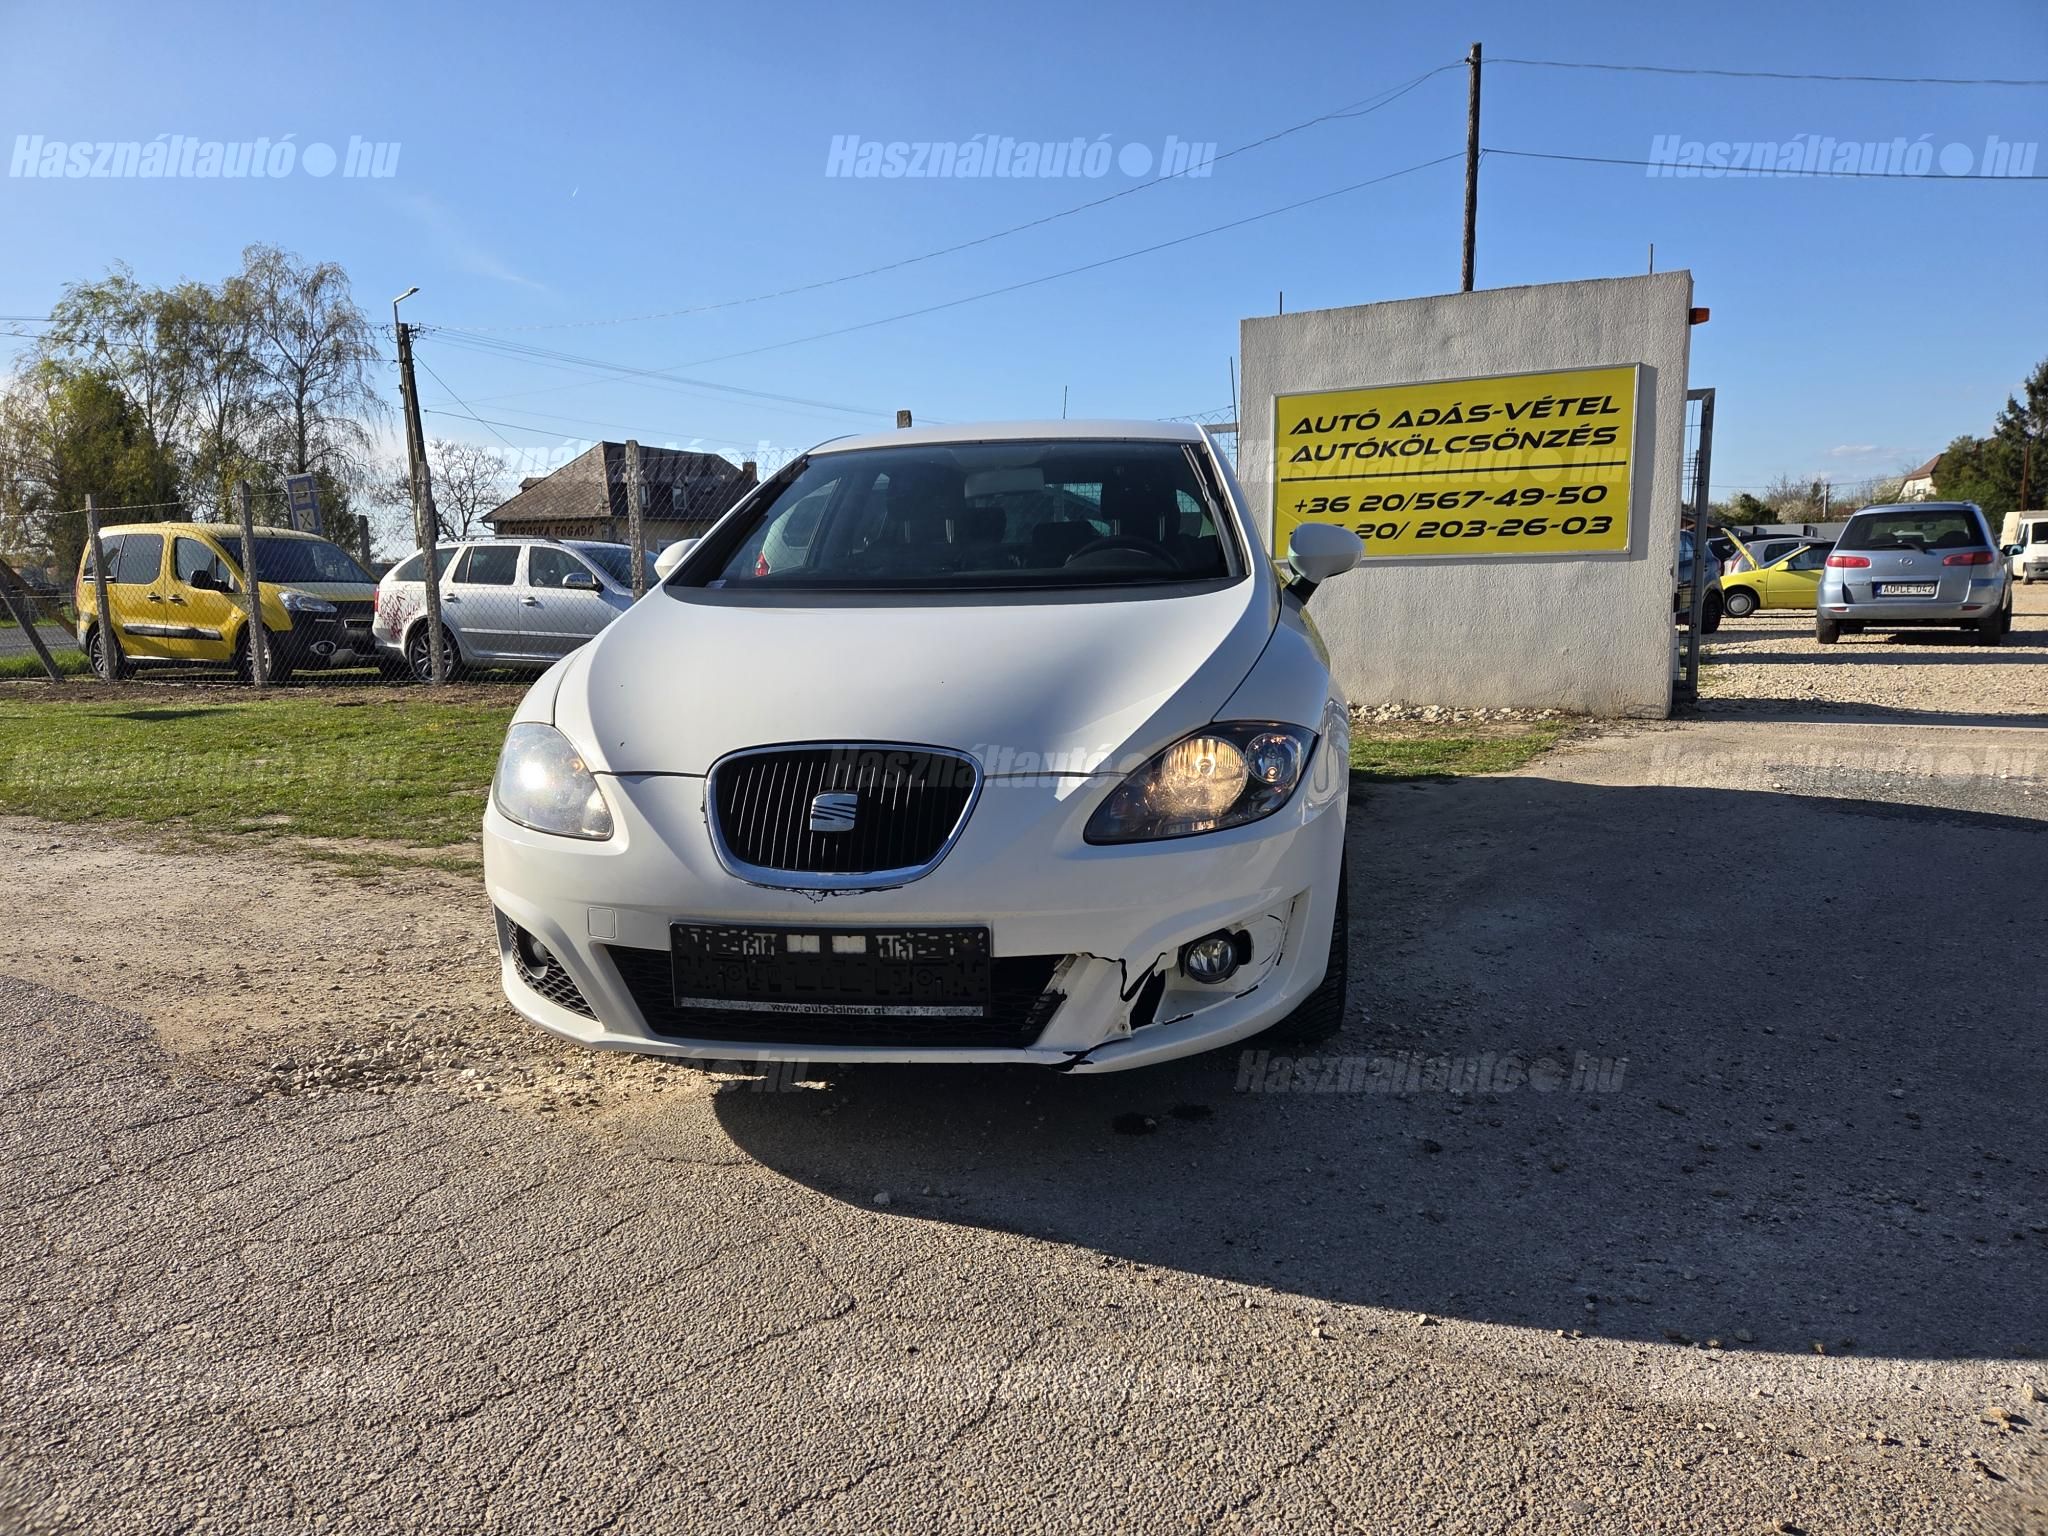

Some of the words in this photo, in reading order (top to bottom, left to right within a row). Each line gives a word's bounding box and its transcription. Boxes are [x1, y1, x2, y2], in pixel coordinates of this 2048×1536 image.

[1289, 409, 1381, 435] AUTÓ
[1388, 395, 1621, 429] ADÁS-VÉTEL
[1289, 424, 1620, 463] AUTÓKÖLCSÖNZÉS
[1294, 495, 1350, 514] +36
[1358, 485, 1608, 513] 20/567-49-50
[1415, 516, 1614, 540] 203-26-03
